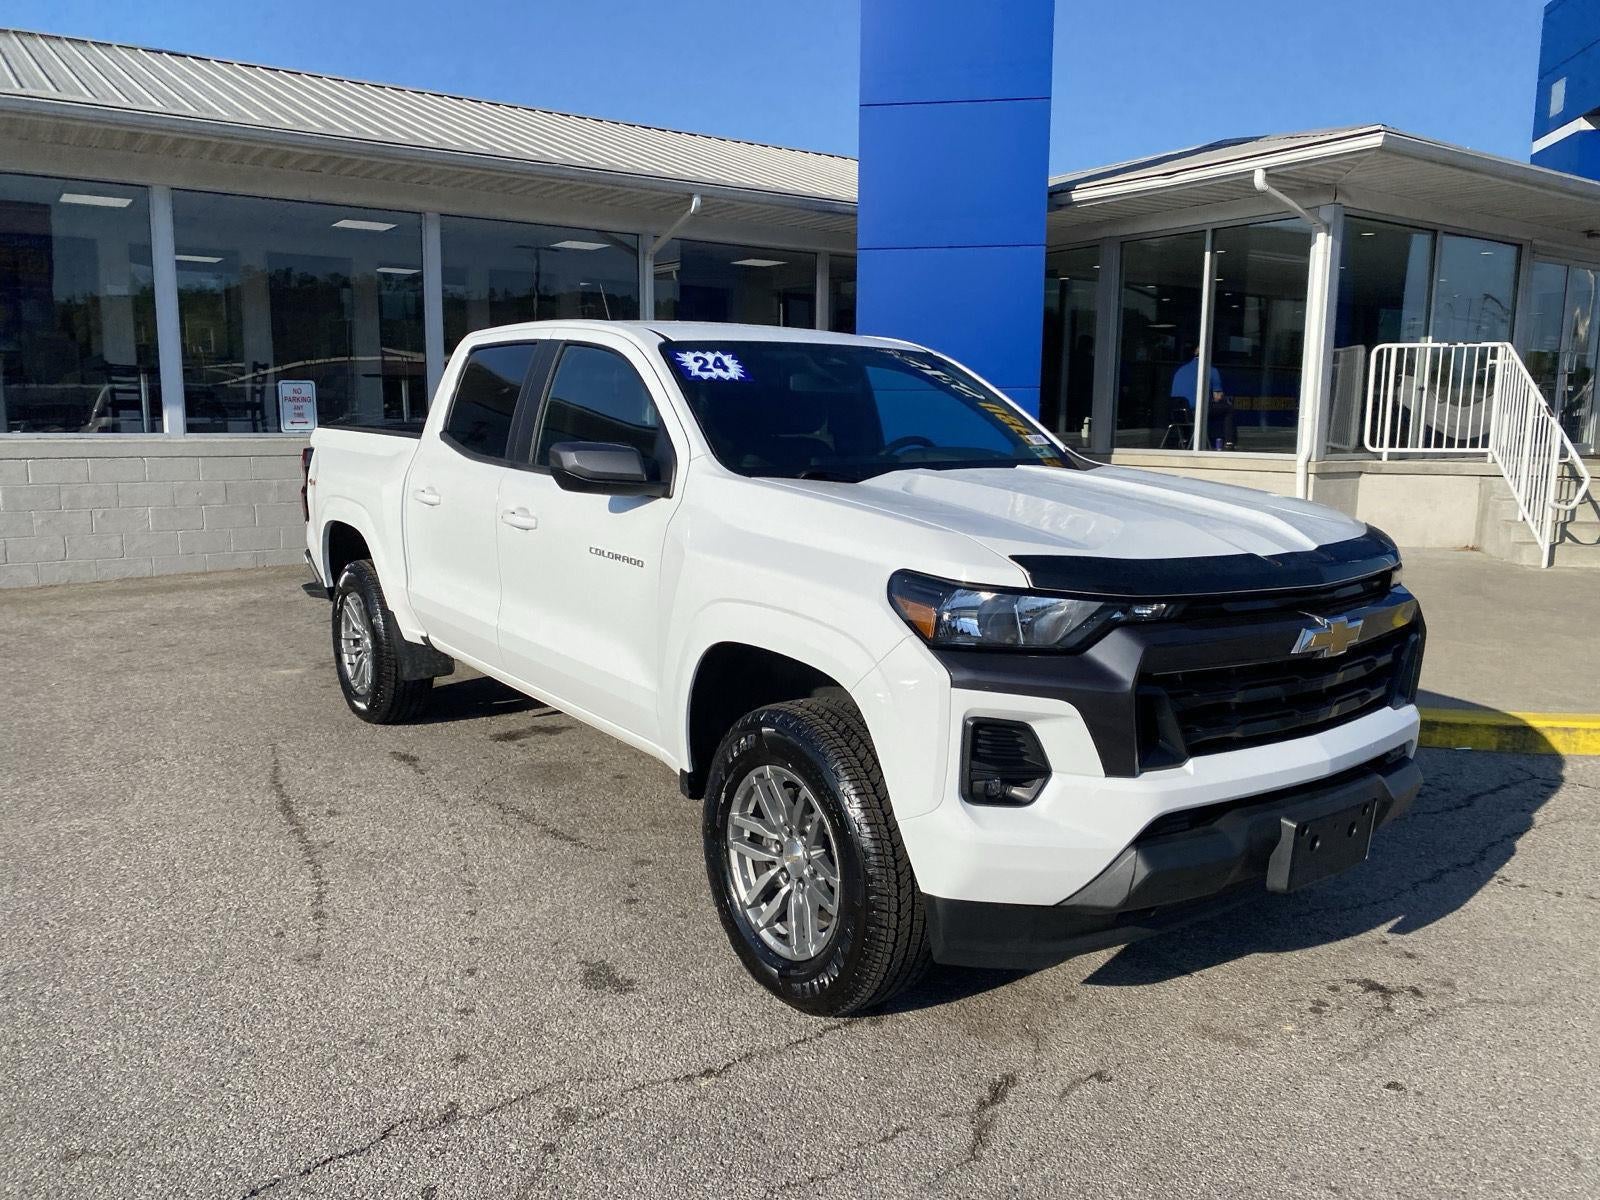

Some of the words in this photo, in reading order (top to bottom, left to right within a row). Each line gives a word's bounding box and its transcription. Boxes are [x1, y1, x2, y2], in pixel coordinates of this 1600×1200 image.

[693, 356, 730, 373] 24
[292, 387, 302, 395] NO
[589, 546, 645, 568] COLORADO
